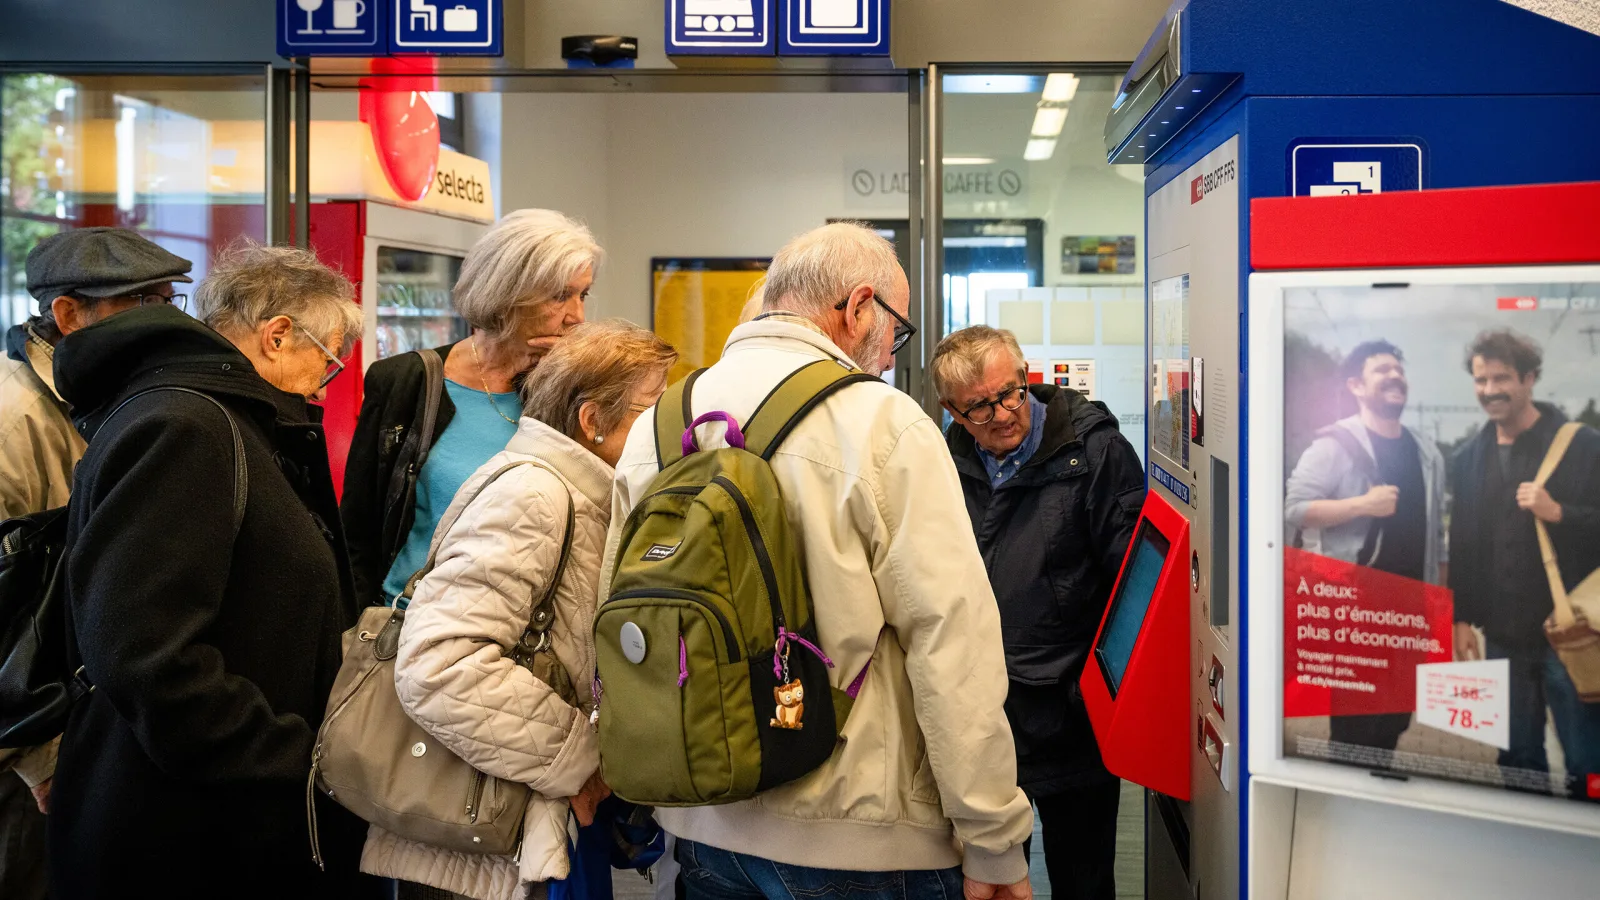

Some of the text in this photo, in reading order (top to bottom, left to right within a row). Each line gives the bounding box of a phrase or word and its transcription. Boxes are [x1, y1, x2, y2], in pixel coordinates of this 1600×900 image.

[437, 168, 484, 204] selecta
[1203, 159, 1235, 195] SBB CFF FFS
[1368, 166, 1373, 178] 1
[1296, 575, 1358, 600] À deux:
[1297, 602, 1430, 631] plus d'émotions,
[1297, 624, 1445, 653] plus d'économies.
[1296, 648, 1388, 668] Voyager maintenant
